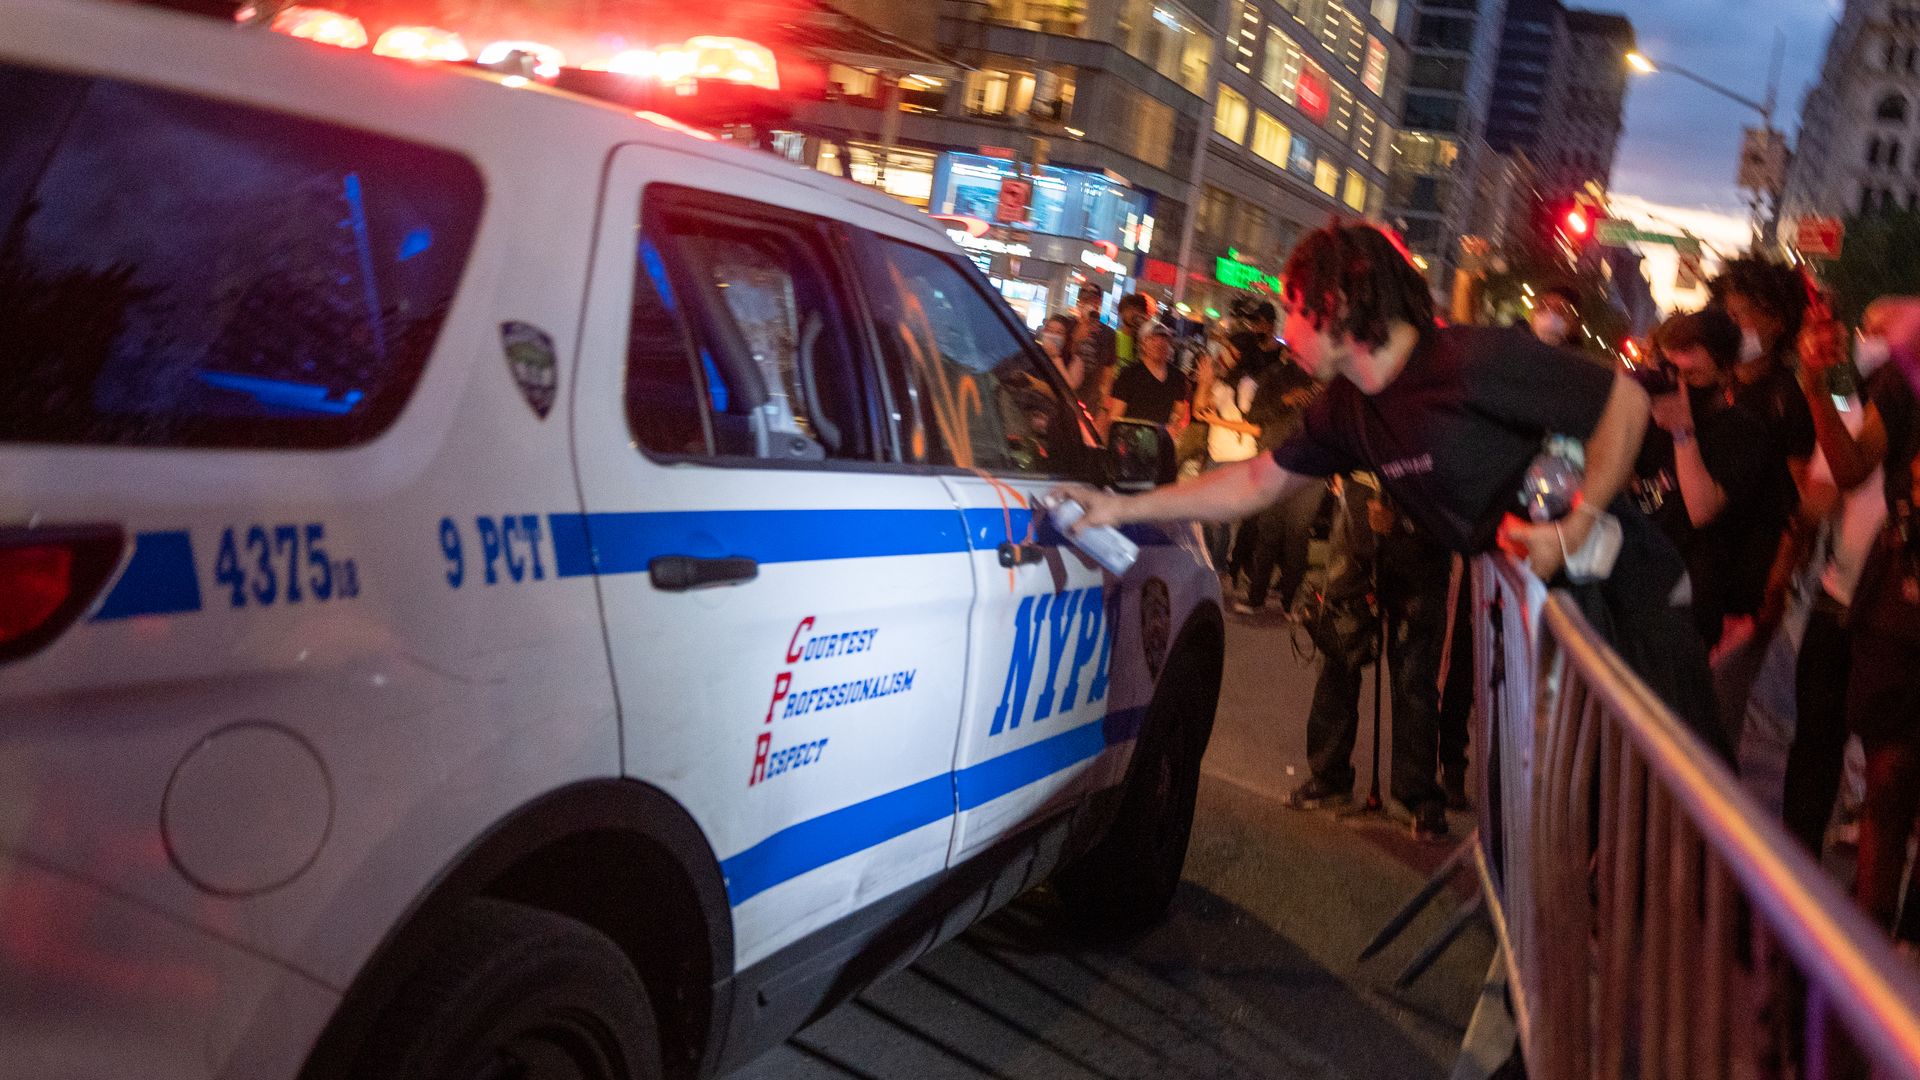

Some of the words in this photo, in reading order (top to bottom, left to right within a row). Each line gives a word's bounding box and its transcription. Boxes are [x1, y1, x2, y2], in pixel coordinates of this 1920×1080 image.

[439, 516, 464, 589] 9
[476, 514, 546, 585] PCT
[785, 615, 879, 665] COURTESY
[765, 668, 917, 724] PROFESSIONALISM
[749, 732, 829, 787] RESPECT
